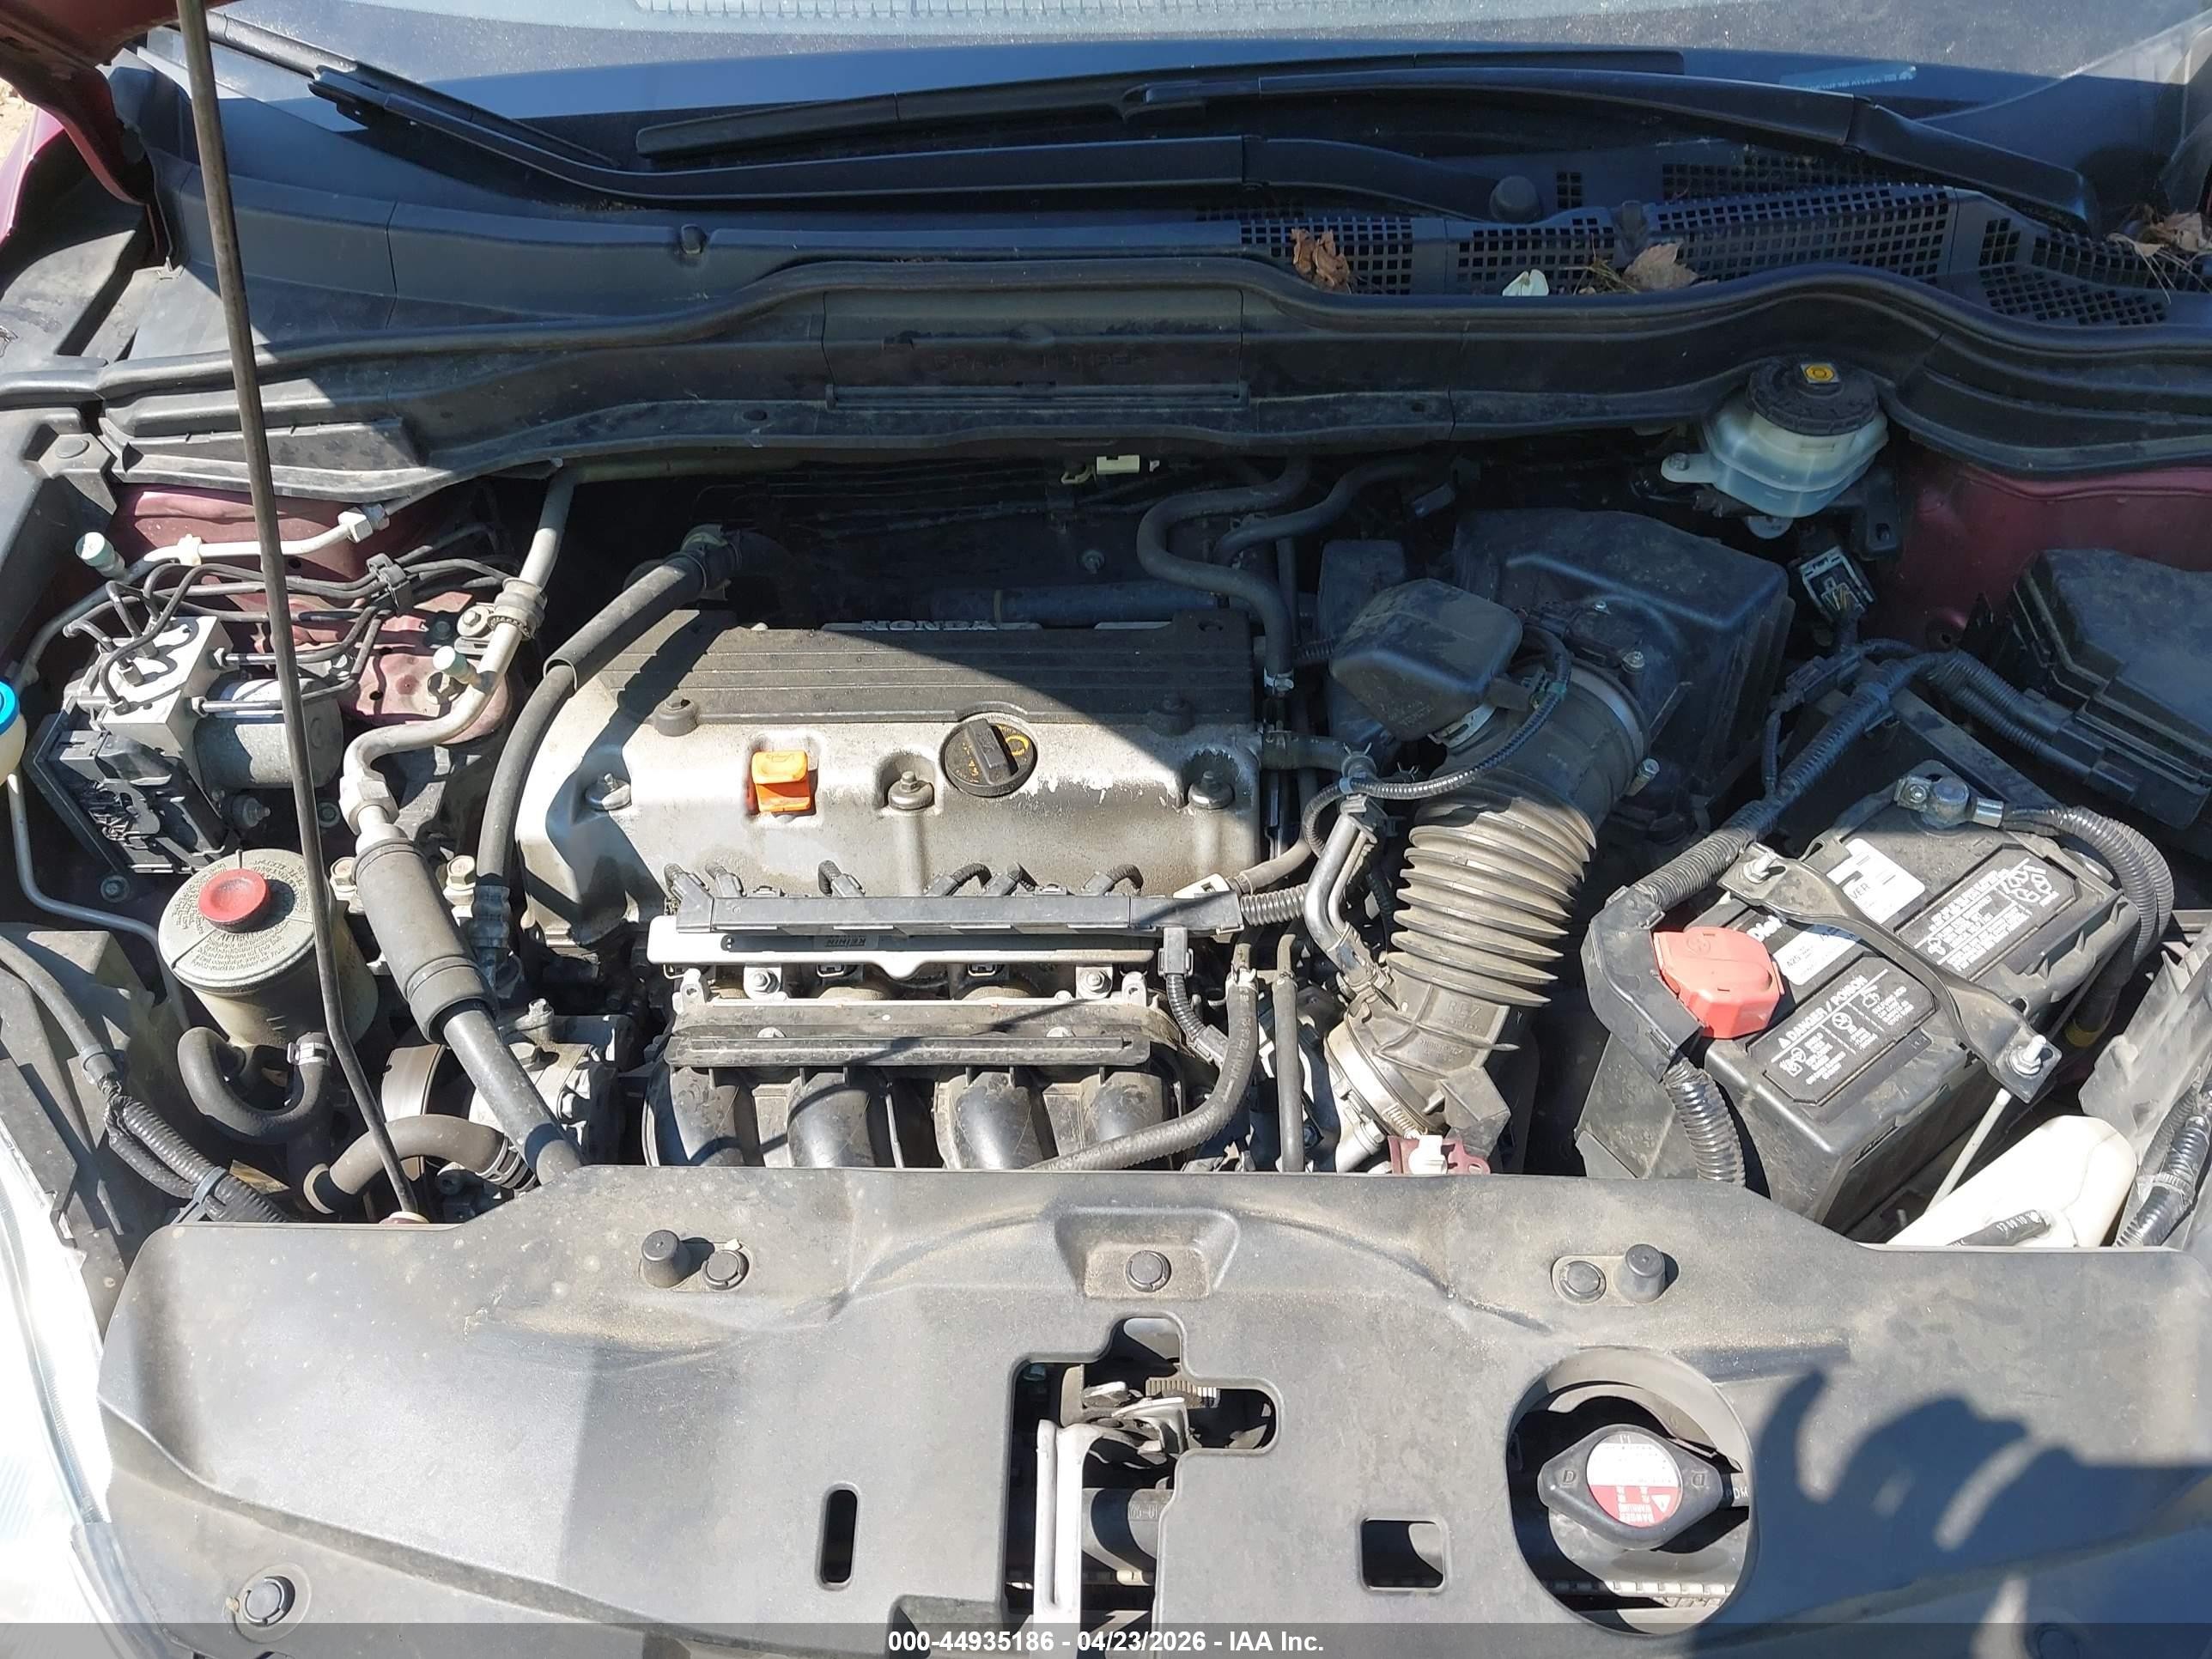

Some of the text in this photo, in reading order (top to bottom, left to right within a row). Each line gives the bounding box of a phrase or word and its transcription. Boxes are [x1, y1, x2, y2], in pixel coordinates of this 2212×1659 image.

[861, 620, 997, 631] HONDA
[825, 935, 866, 948] KEIHIN
[1785, 1007, 1827, 1042] DANGER
